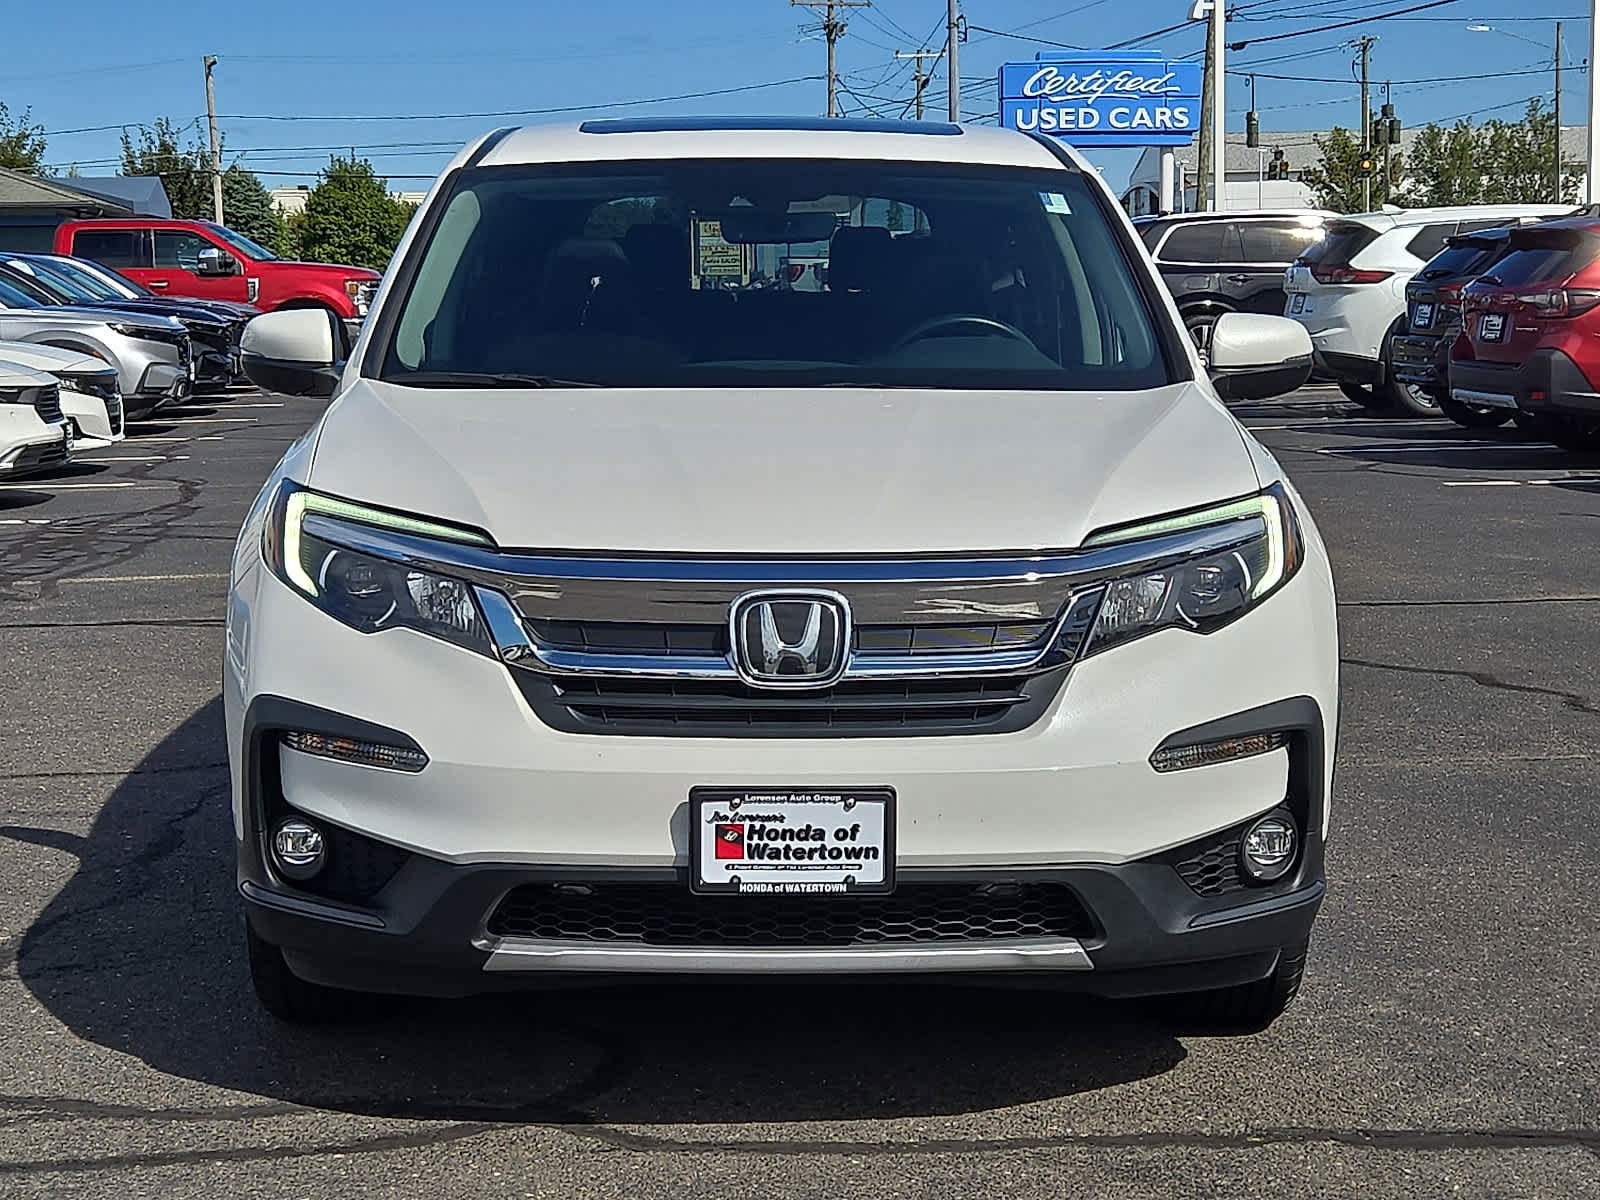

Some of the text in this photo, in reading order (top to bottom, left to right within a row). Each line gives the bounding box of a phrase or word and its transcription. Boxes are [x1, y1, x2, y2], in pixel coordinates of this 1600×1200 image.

[1023, 66, 1181, 105] Certified
[1016, 106, 1190, 130] USED CARS
[744, 793, 842, 803] Lorensen Auto Group
[746, 823, 861, 842] Honda of
[746, 842, 880, 861] Watertown
[739, 883, 848, 893] HONDA of WATERTOWN
